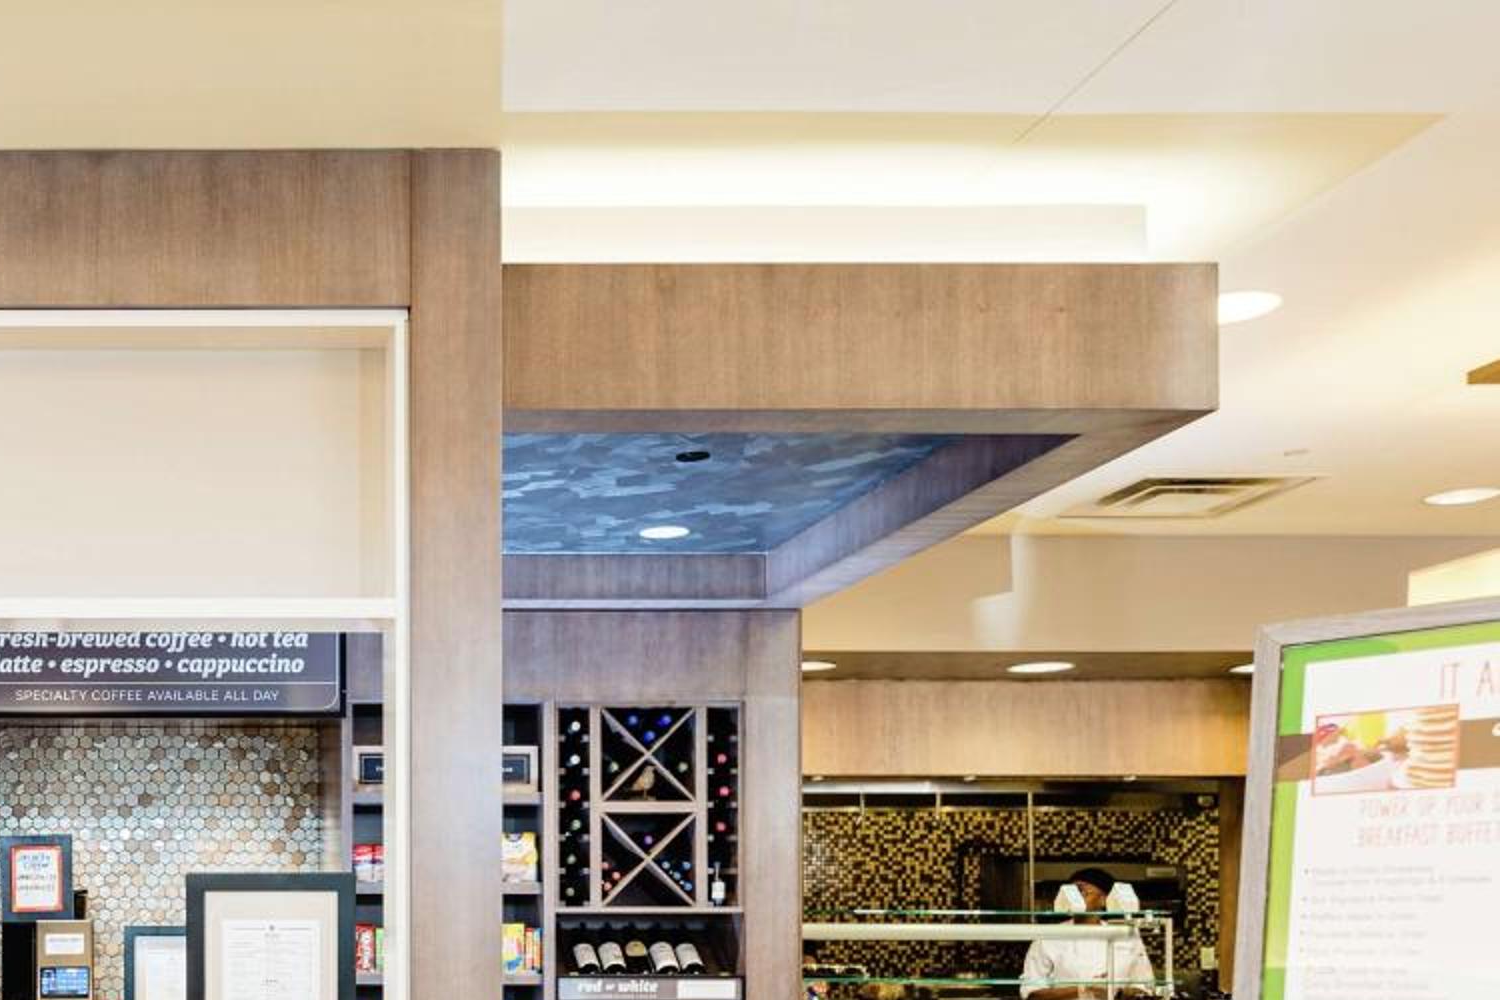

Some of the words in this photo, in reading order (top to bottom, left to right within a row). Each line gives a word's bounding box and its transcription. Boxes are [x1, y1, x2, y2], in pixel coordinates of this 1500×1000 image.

[145, 631, 213, 653] coffee
[230, 631, 269, 648] hot
[272, 631, 309, 648] tea
[59, 658, 160, 679] espresso
[176, 653, 305, 679] cappuccino
[14, 688, 88, 701] SPECIALTY
[91, 688, 142, 701] COFFEE
[147, 688, 219, 701] AVAILABLE
[223, 688, 249, 701] ALL
[252, 688, 280, 701] DAY
[618, 979, 659, 993] white
